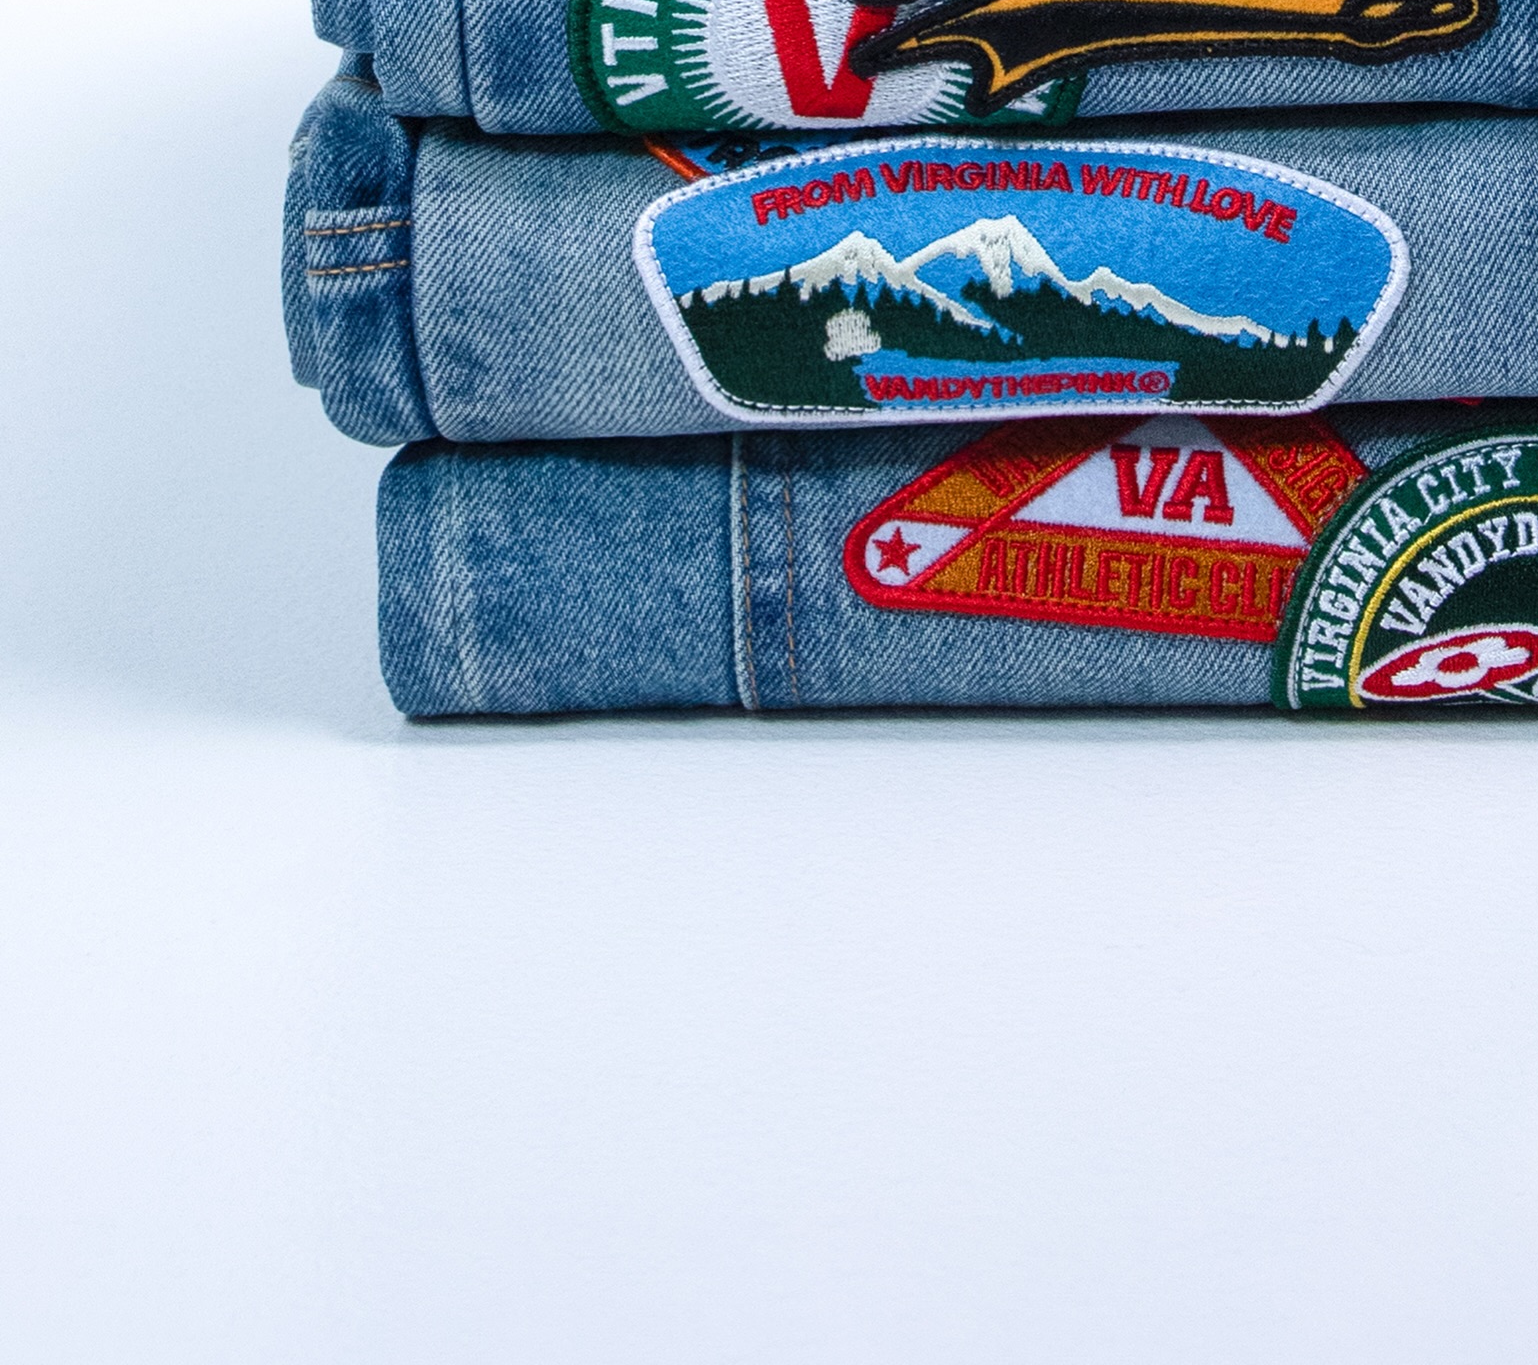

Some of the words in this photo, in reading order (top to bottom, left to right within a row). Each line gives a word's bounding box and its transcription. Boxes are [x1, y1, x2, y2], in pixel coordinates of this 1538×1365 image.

[752, 167, 876, 226] FROM
[879, 160, 1074, 194] VIRGINIA
[1080, 162, 1189, 208] WITH
[1188, 178, 1297, 245] LOVE
[1109, 444, 1235, 526] VA
[975, 536, 1198, 612] ATHLETIC
[1302, 497, 1425, 691] VIRGINIA
[1416, 447, 1523, 513] CITY
